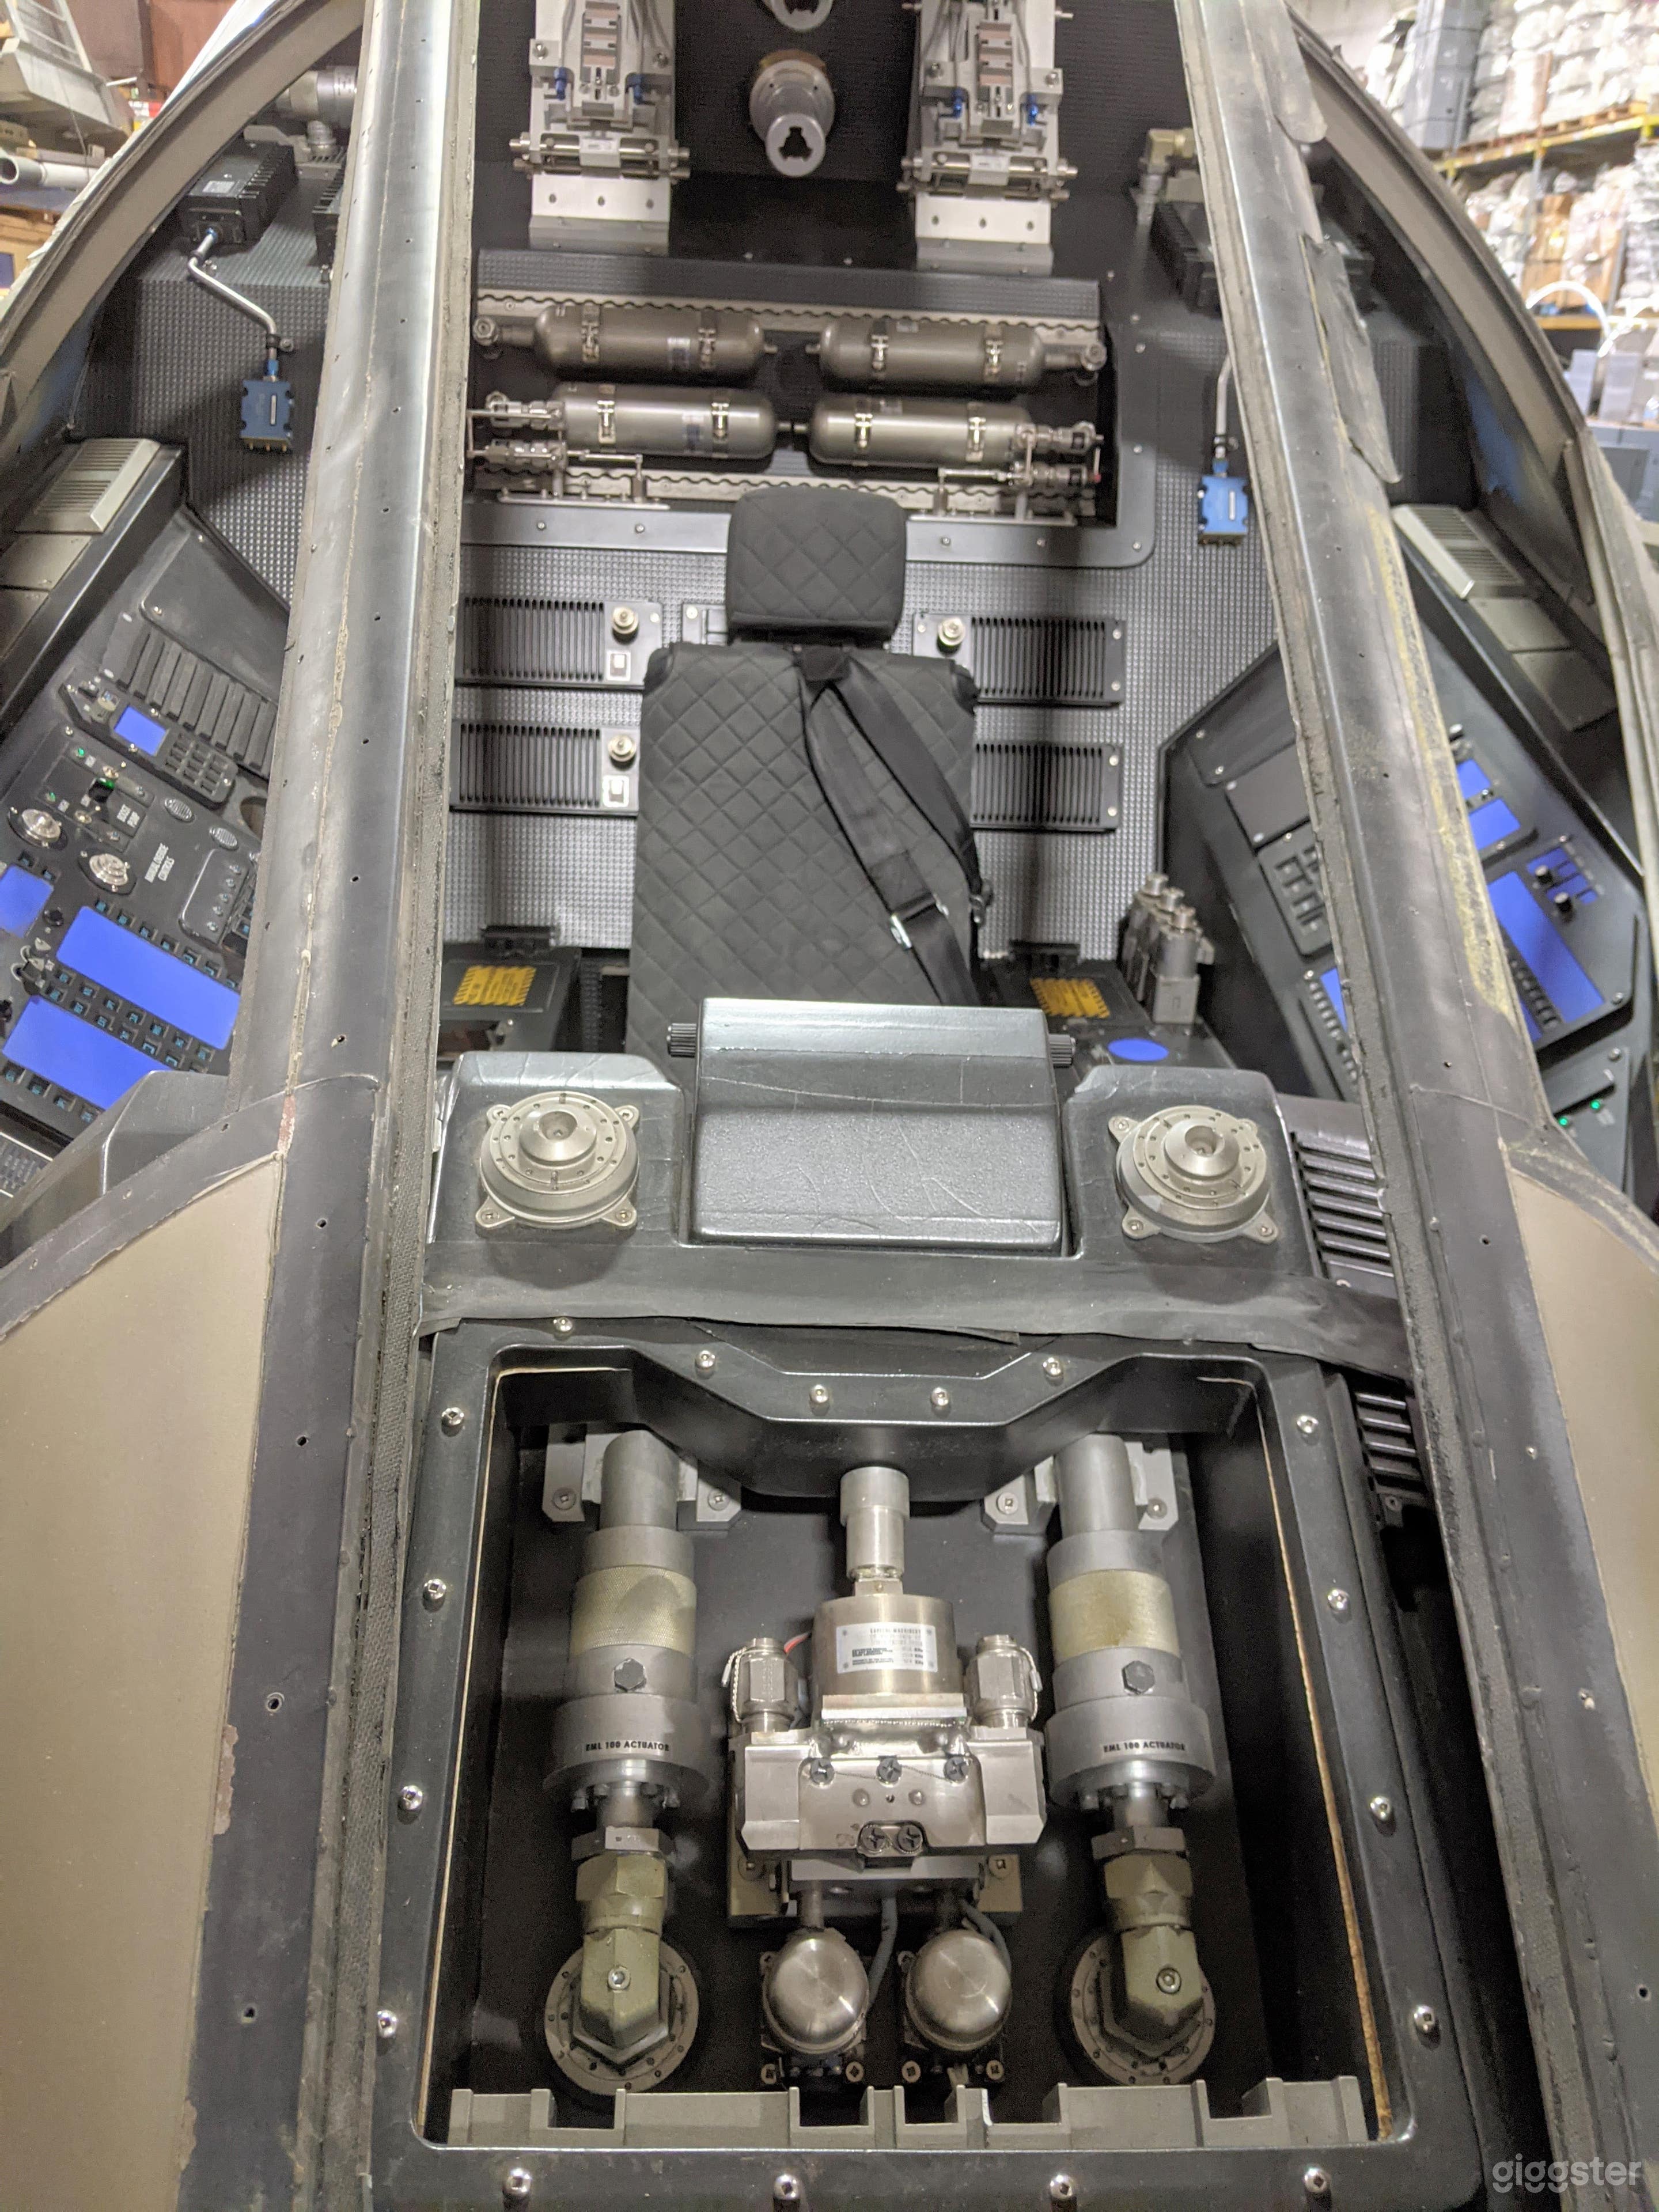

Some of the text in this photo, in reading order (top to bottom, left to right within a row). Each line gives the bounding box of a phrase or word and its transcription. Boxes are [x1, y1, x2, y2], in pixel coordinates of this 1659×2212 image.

[605, 1741, 621, 1749] 100
[624, 1741, 669, 1751] ACTUATOR
[1143, 1741, 1185, 1751] ACTUATOR
